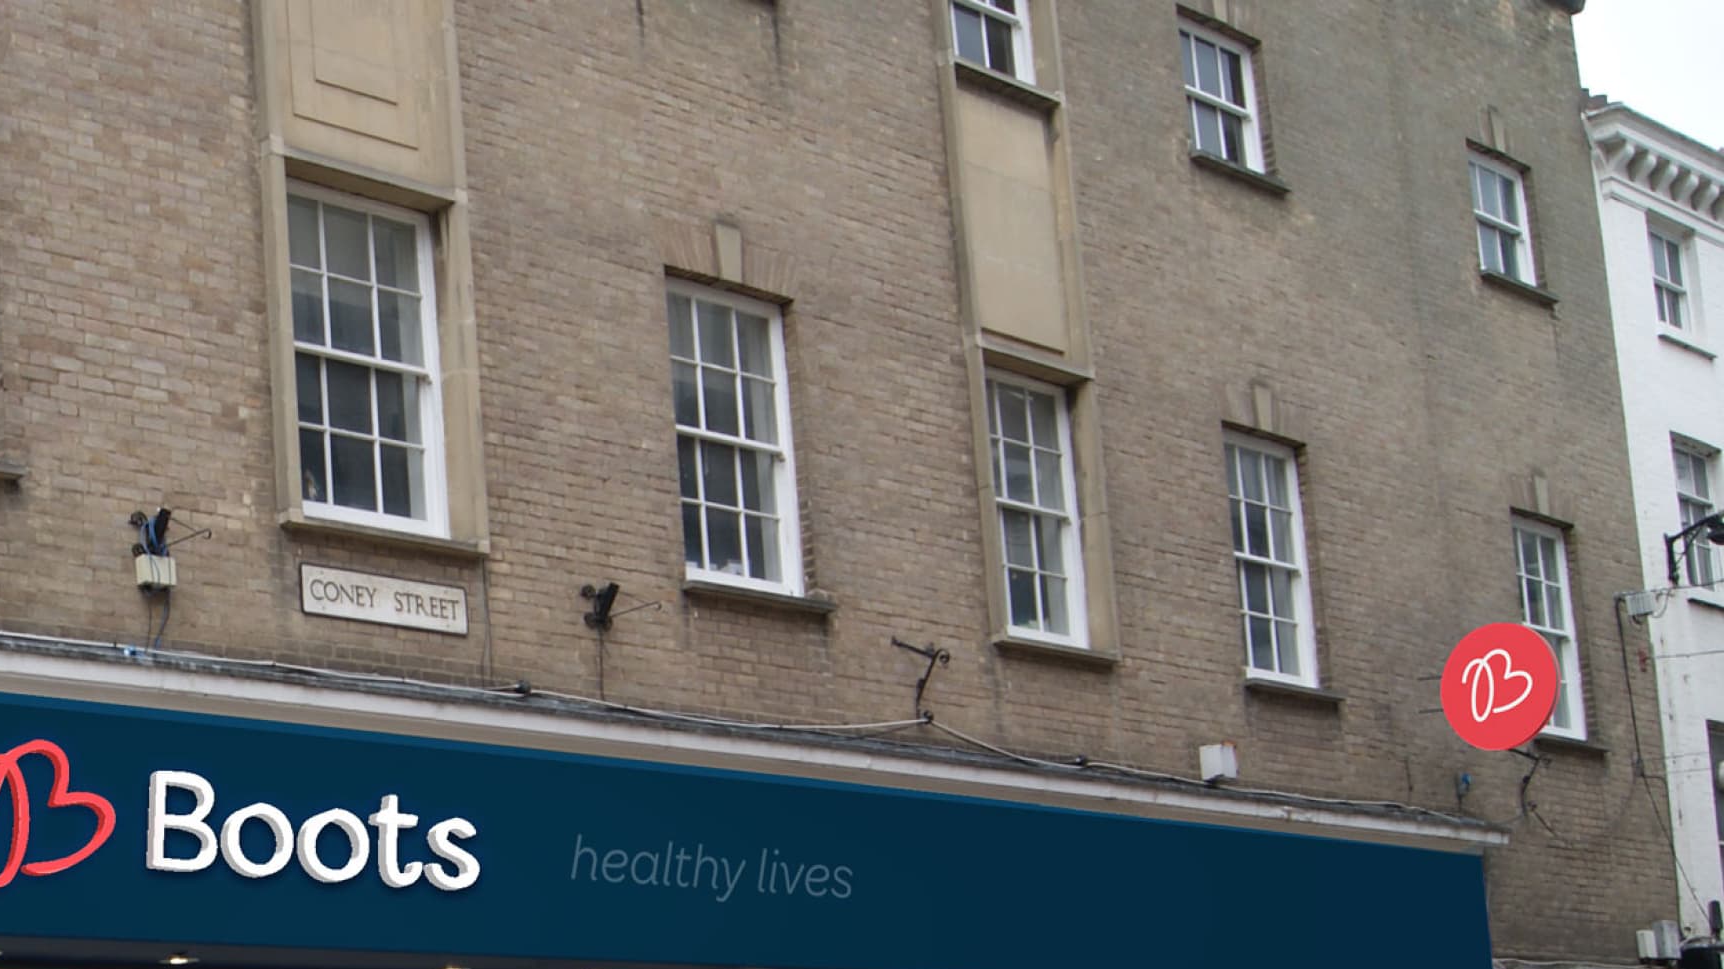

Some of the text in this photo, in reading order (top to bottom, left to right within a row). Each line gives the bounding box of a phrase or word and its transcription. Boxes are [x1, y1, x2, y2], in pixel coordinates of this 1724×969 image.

[310, 579, 460, 621] CONEY STREET
[145, 770, 482, 892] Boots
[570, 833, 854, 903] healthy lives
